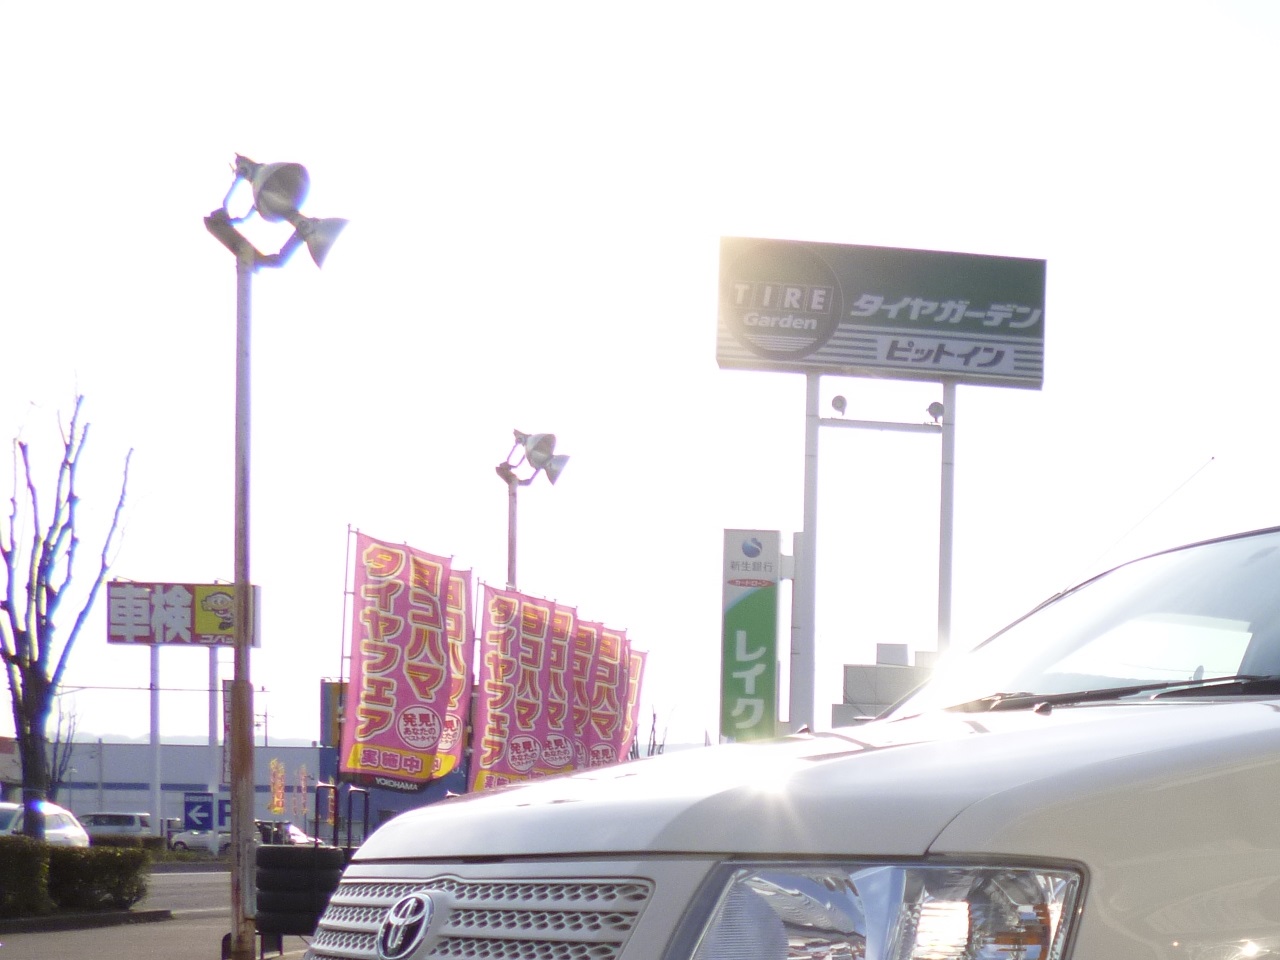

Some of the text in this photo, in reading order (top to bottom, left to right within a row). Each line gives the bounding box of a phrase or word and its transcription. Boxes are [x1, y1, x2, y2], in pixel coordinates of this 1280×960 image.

[733, 284, 828, 312] TIRE
[743, 313, 818, 330] Garden
[851, 294, 1042, 328] タイヤガーデン
[885, 340, 1005, 368] ピットイン
[109, 584, 194, 643] 車検
[357, 545, 405, 739] タイヤフェア
[405, 556, 445, 702] ヨコハマ
[479, 594, 519, 769] タイヤフェア
[515, 601, 550, 731] ヨコハマ
[590, 631, 621, 740] ヨコハマ
[731, 630, 767, 729] レイク
[360, 748, 422, 773] 実施中
[375, 777, 418, 791] YOKOHAMA
